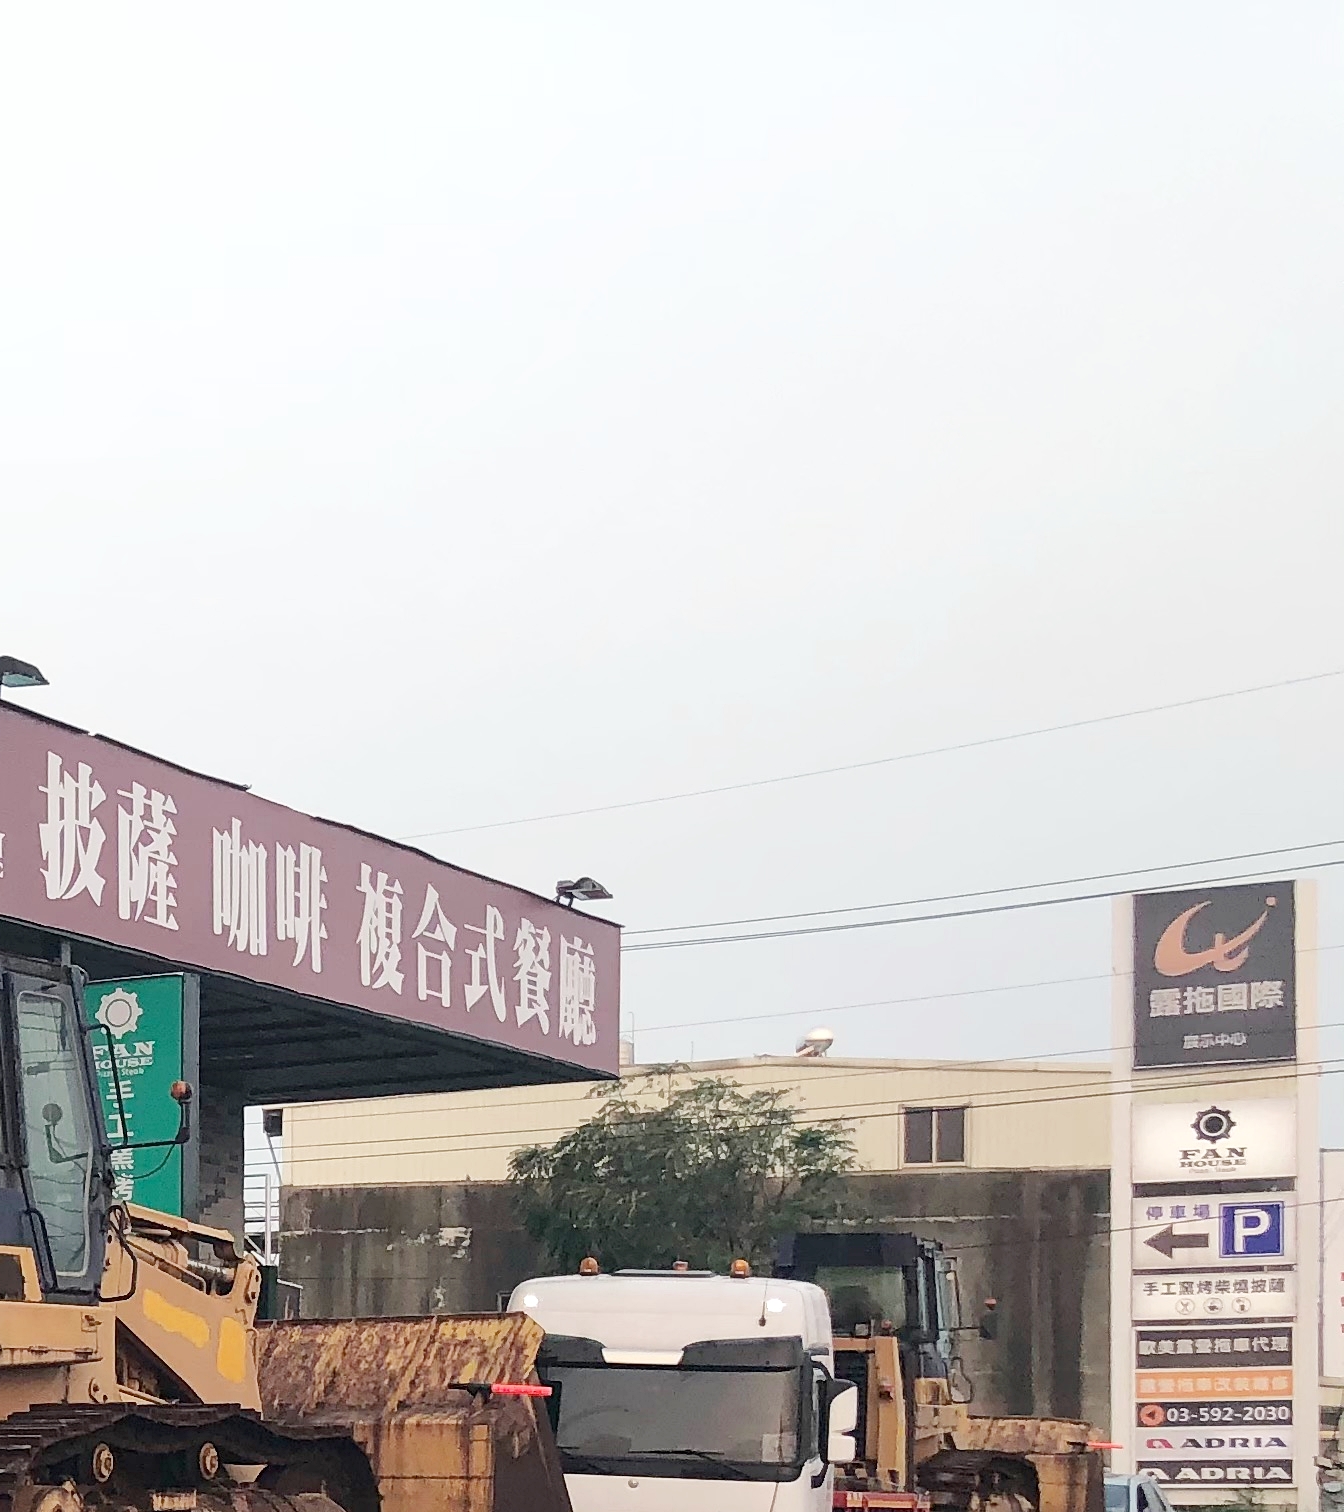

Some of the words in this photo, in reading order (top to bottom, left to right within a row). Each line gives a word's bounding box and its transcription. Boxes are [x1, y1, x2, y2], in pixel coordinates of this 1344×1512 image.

[38, 751, 179, 931] 披薩
[212, 817, 329, 973] 咖啡
[356, 862, 598, 1047] 複合式餐廳
[1179, 1147, 1248, 1160] FAN
[1179, 1158, 1247, 1169] HOUSE
[1146, 1203, 1210, 1221] 停車場
[1233, 1208, 1272, 1253] P
[1166, 1405, 1291, 1423] 03-592-2030
[1180, 1437, 1288, 1449] ADRIA
[1174, 1466, 1292, 1481] ADRIA
